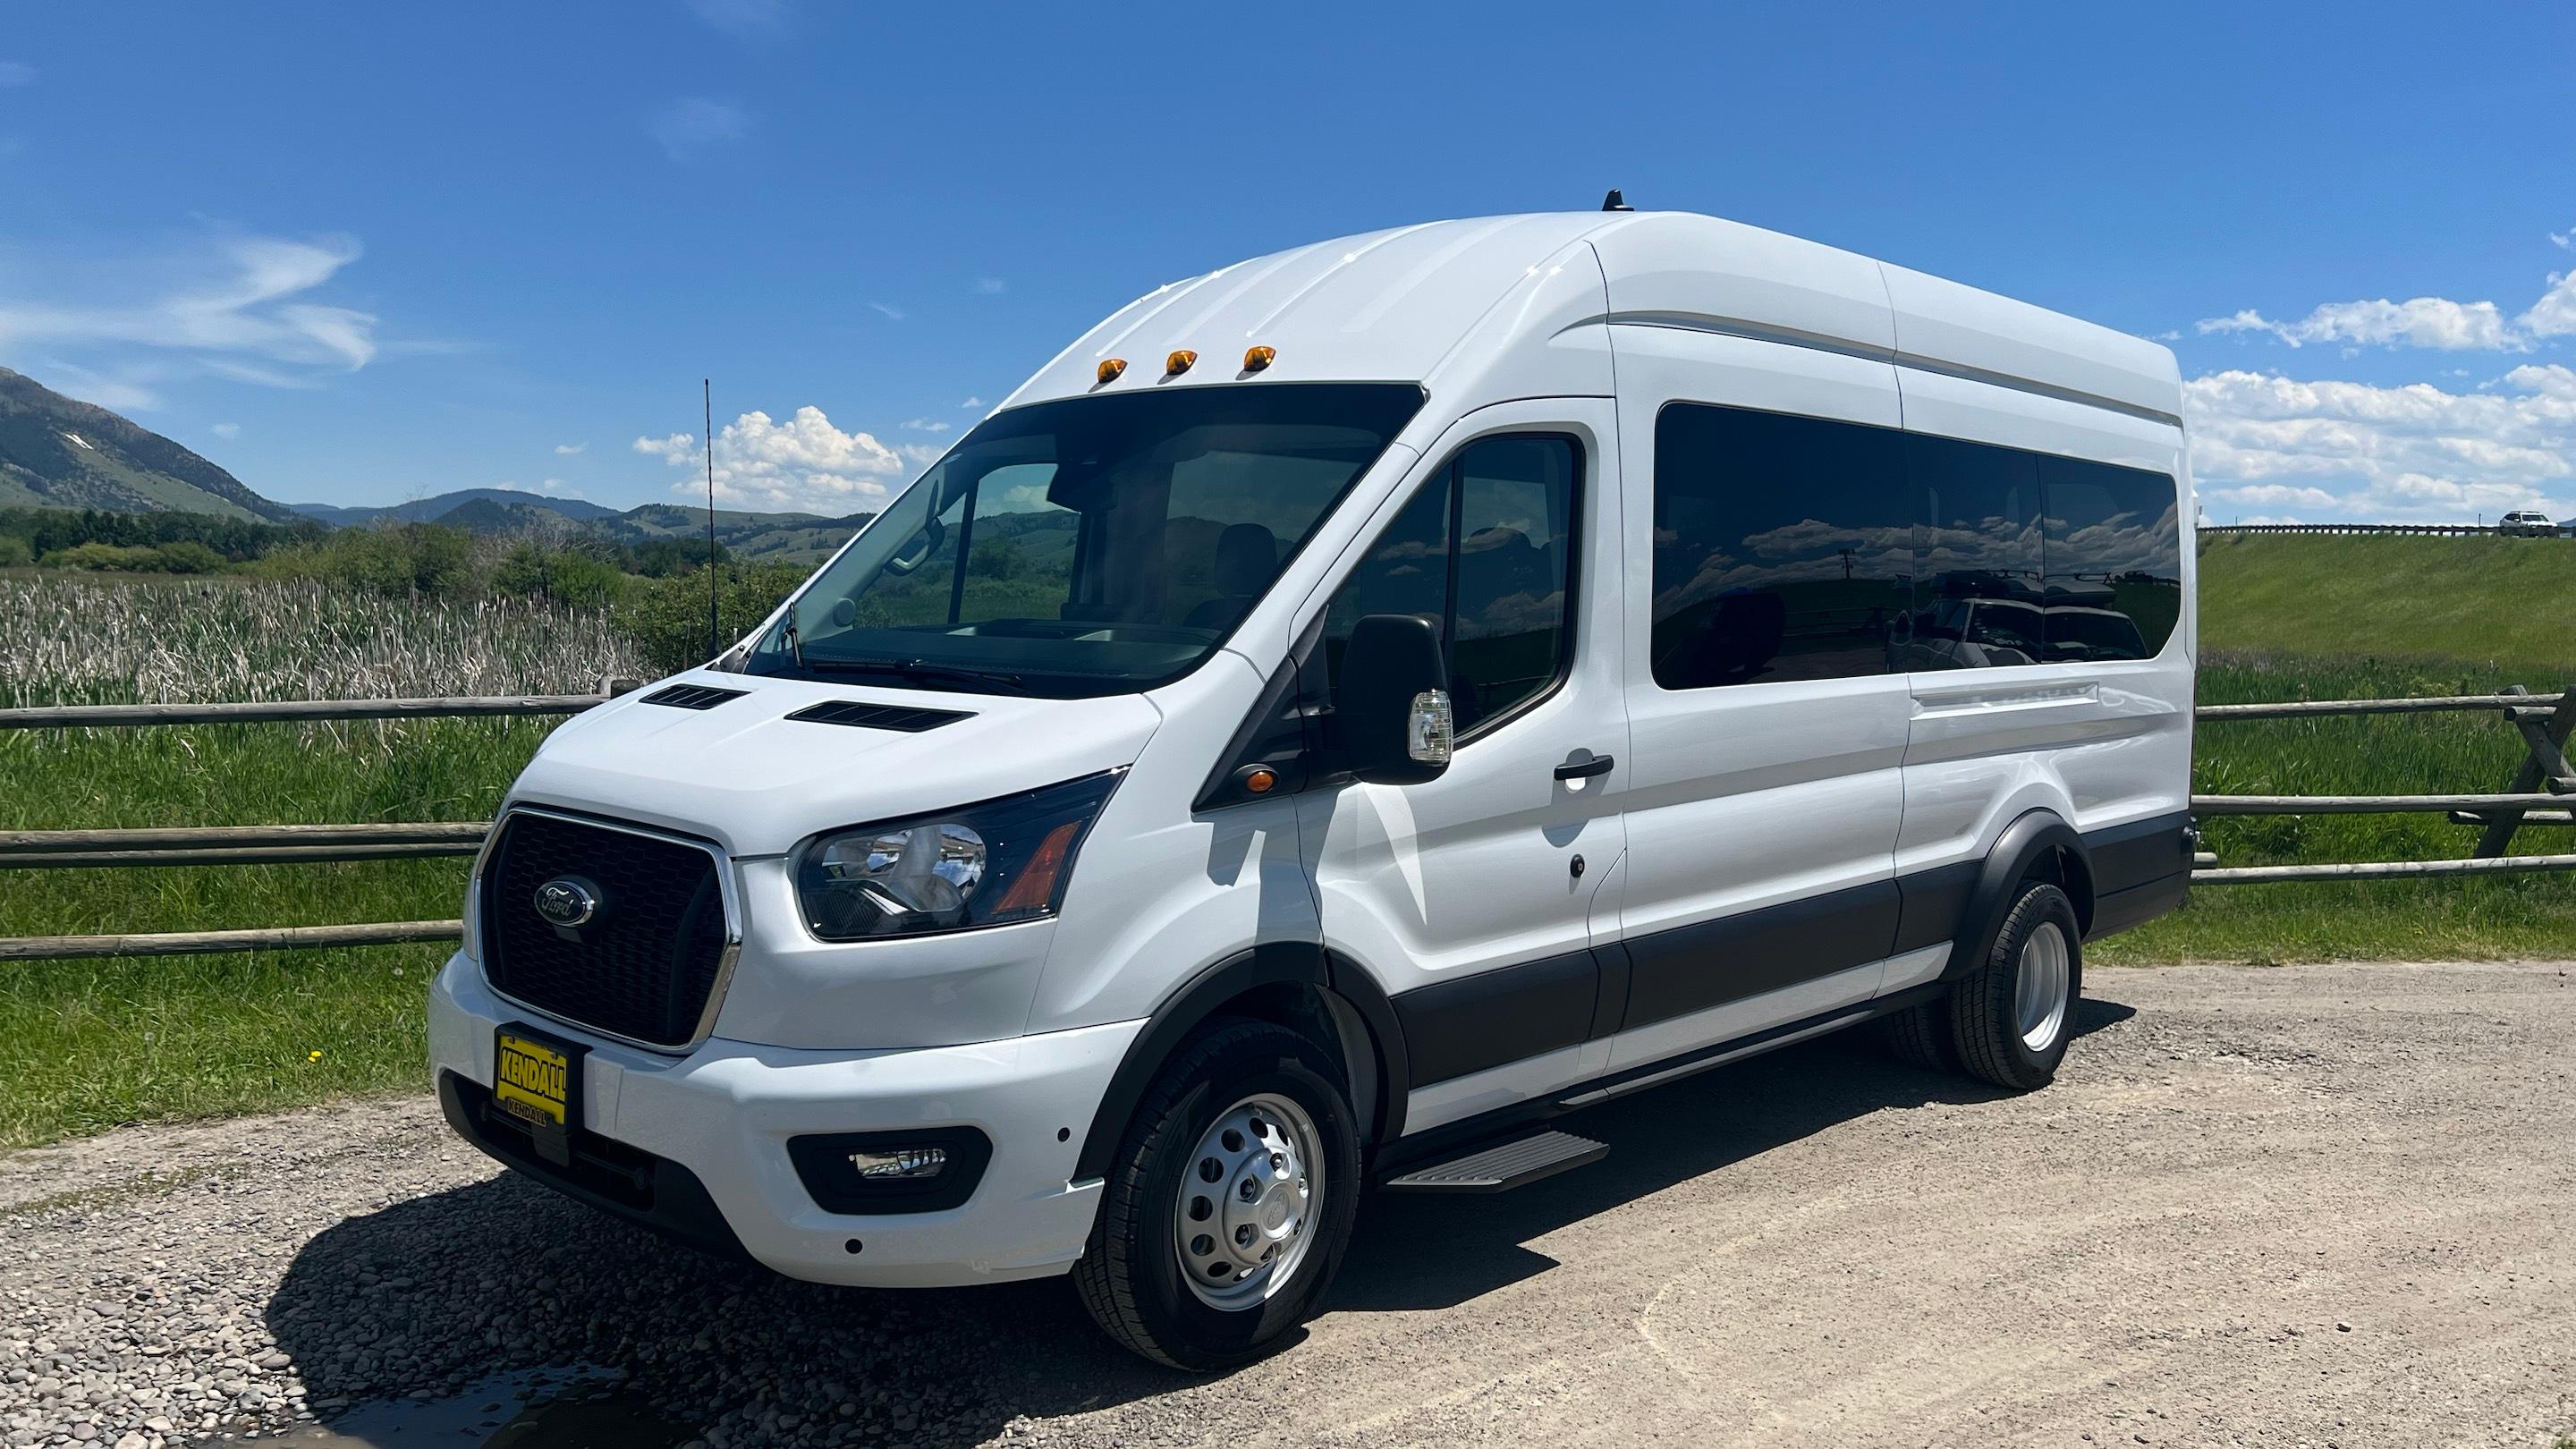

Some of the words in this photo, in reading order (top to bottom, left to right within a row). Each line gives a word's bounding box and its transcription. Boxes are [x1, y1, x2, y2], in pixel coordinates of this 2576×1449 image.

[541, 886, 574, 917] Ford
[500, 1046, 567, 1103] KENDALL
[508, 1099, 547, 1126] KENDALL
